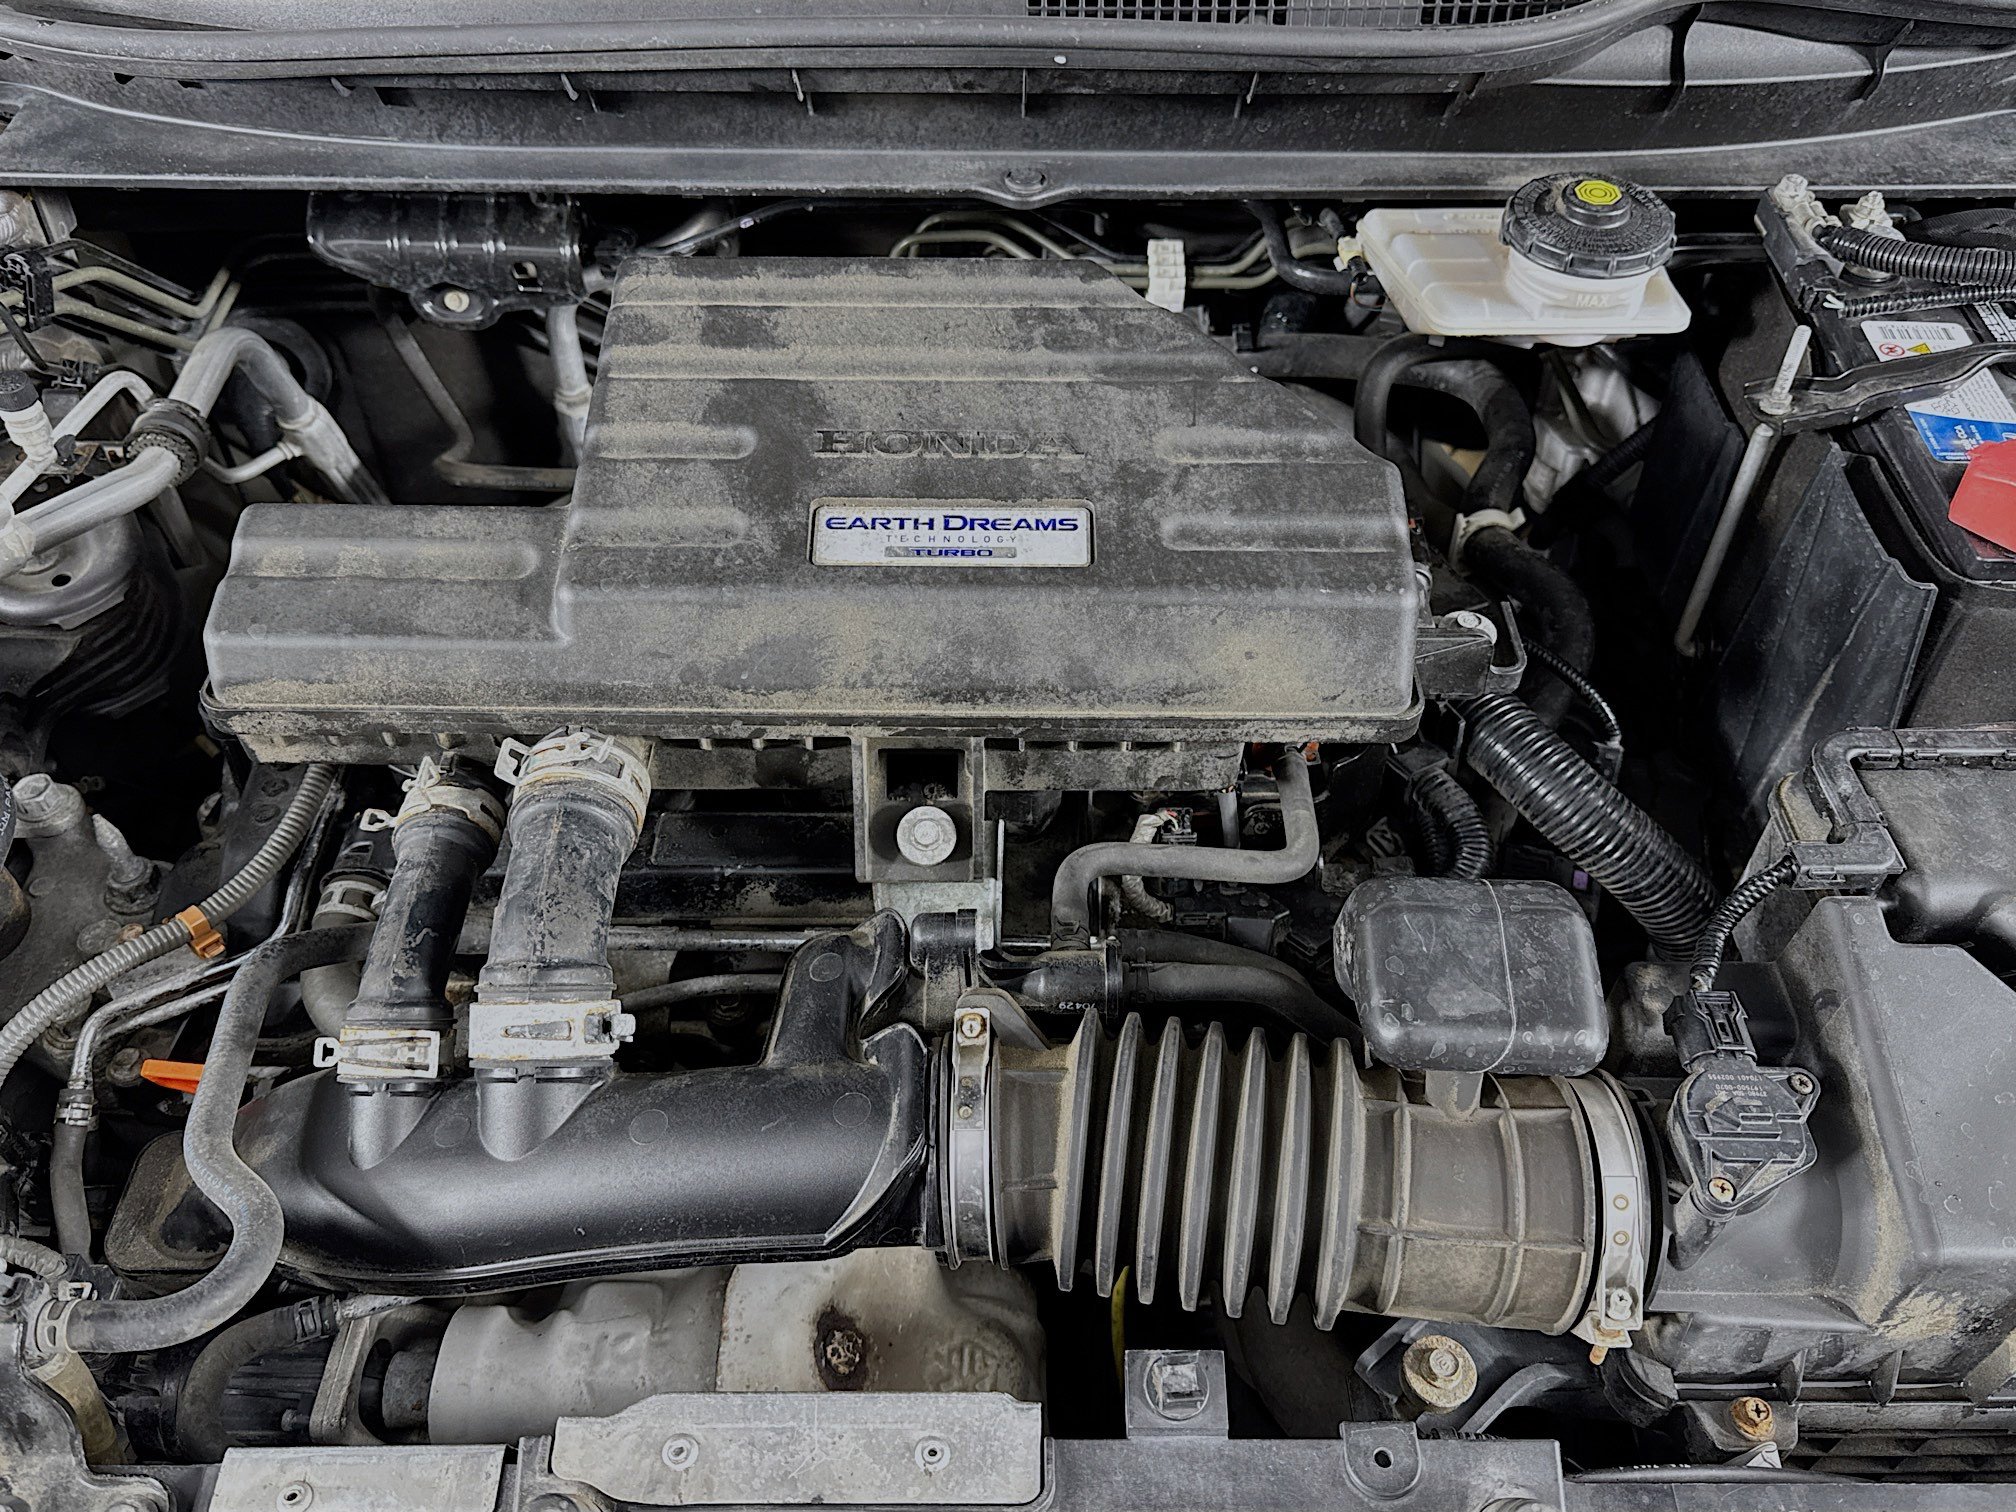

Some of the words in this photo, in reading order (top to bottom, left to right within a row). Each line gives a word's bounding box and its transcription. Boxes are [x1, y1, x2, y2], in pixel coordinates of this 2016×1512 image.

[1575, 293, 1611, 309] MAX
[813, 429, 1085, 459] HONDA
[826, 517, 935, 531] EARTH
[943, 515, 1078, 531] DREAMS
[885, 534, 1018, 544] TECHNOLOGY
[909, 547, 993, 558] TURBO
